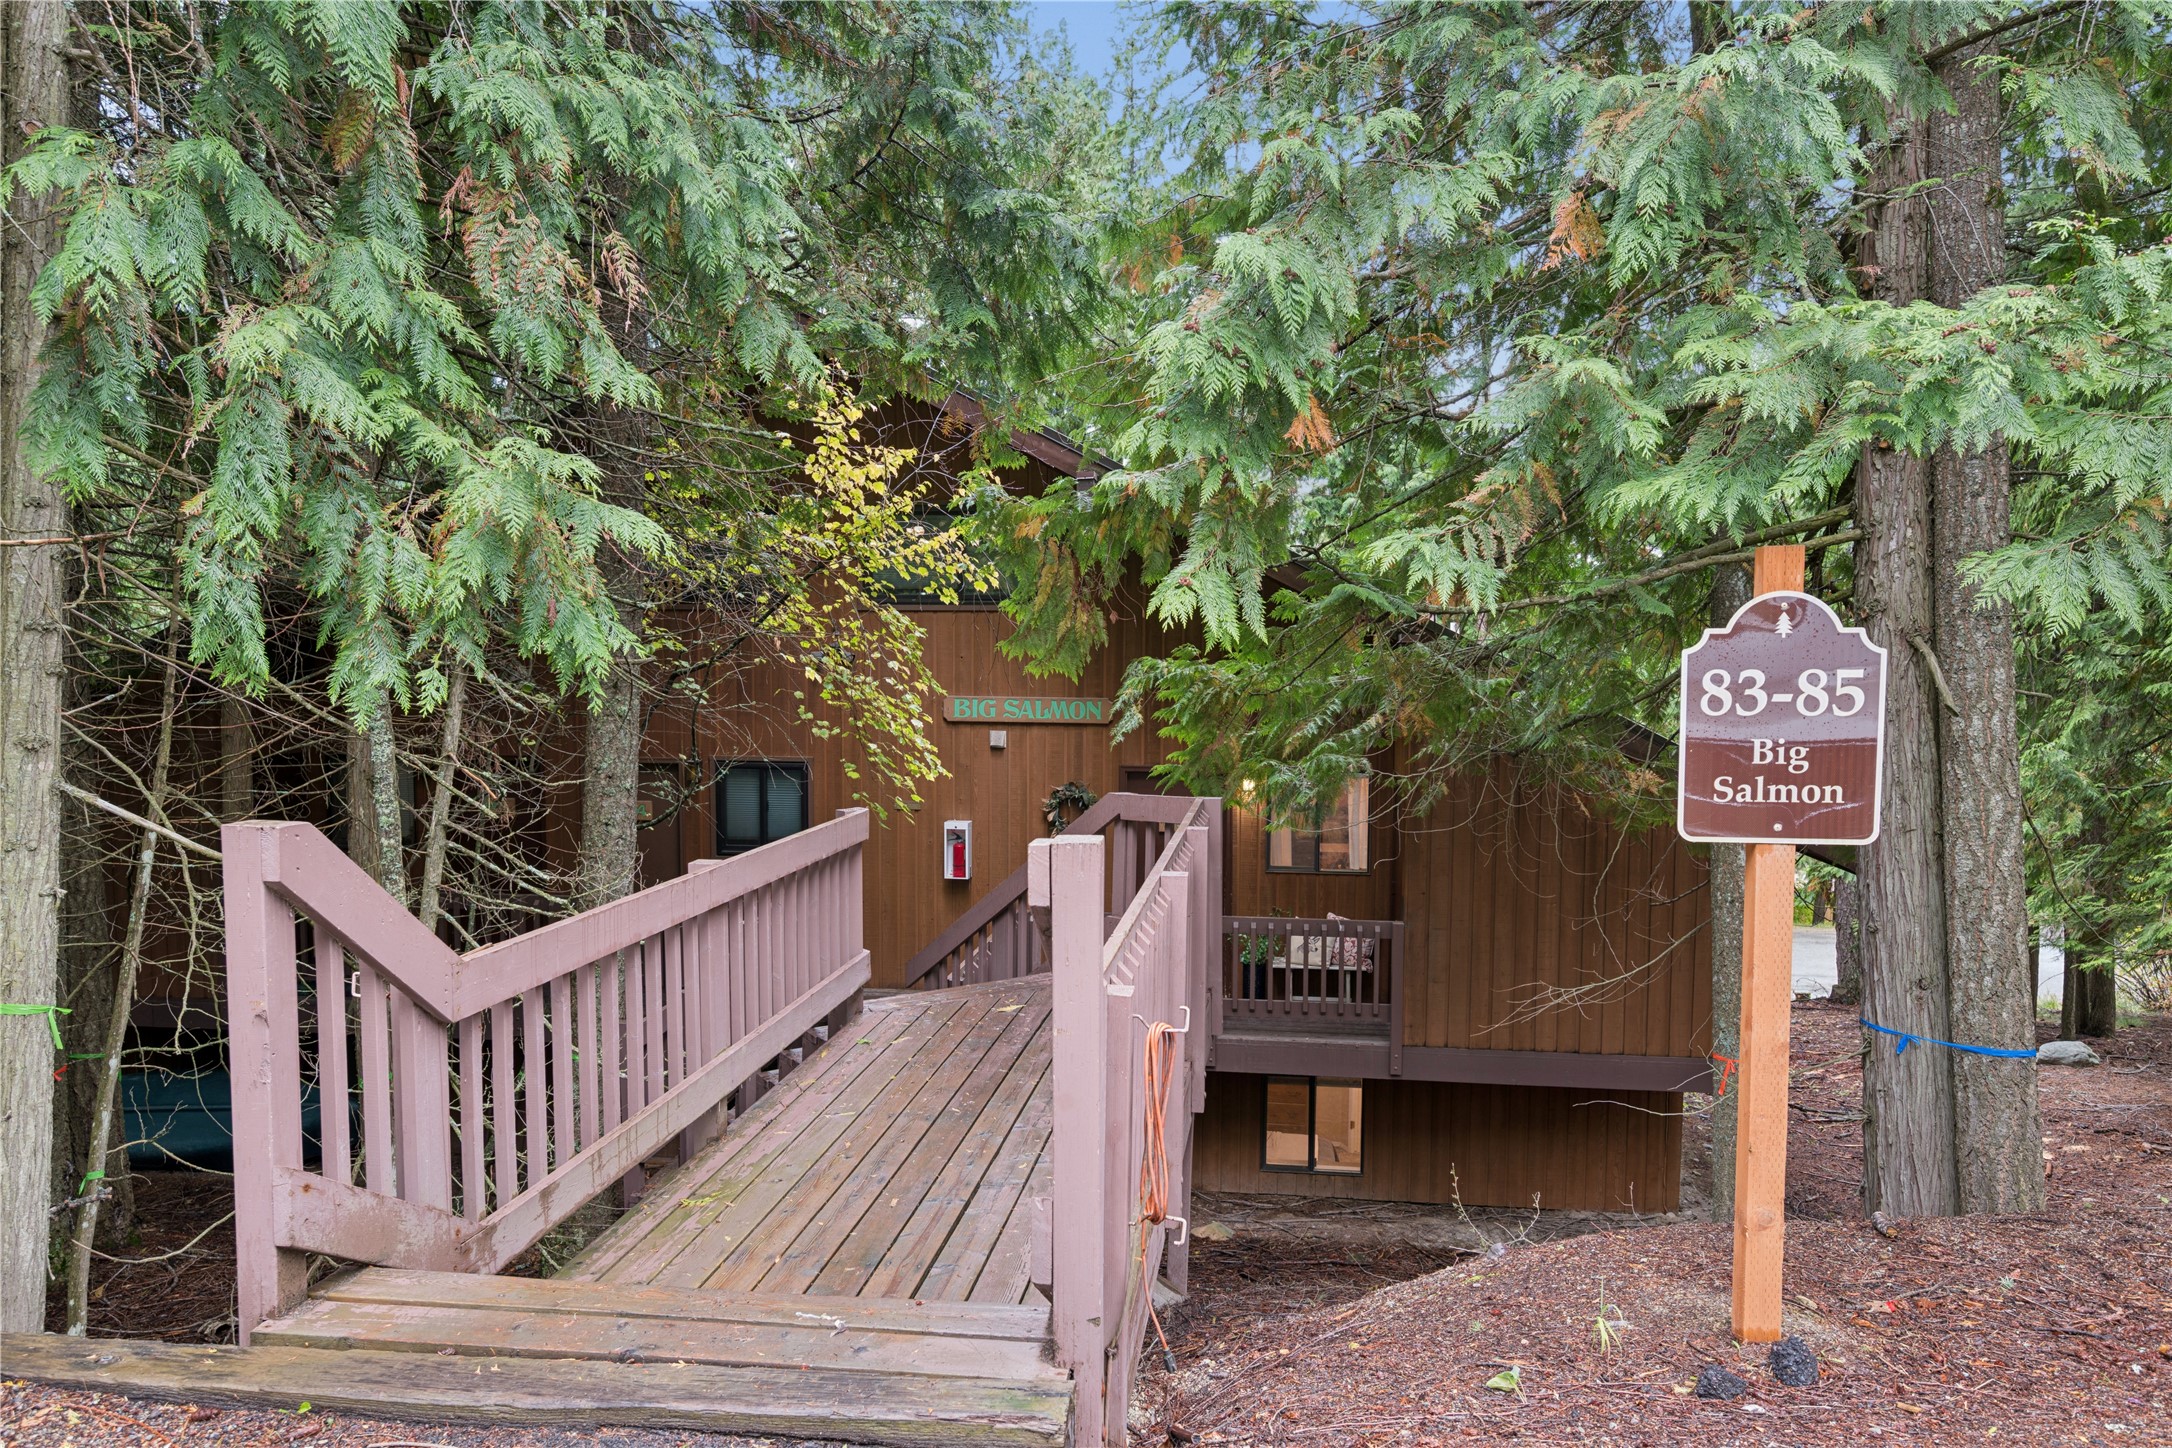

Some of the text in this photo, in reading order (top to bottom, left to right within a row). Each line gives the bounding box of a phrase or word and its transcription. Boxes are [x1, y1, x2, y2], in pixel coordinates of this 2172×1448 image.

[1700, 668, 1865, 716] 83-85
[953, 699, 1102, 720] BIG SALMON
[1751, 738, 1810, 774] Big
[1713, 776, 1845, 804] Salmon
